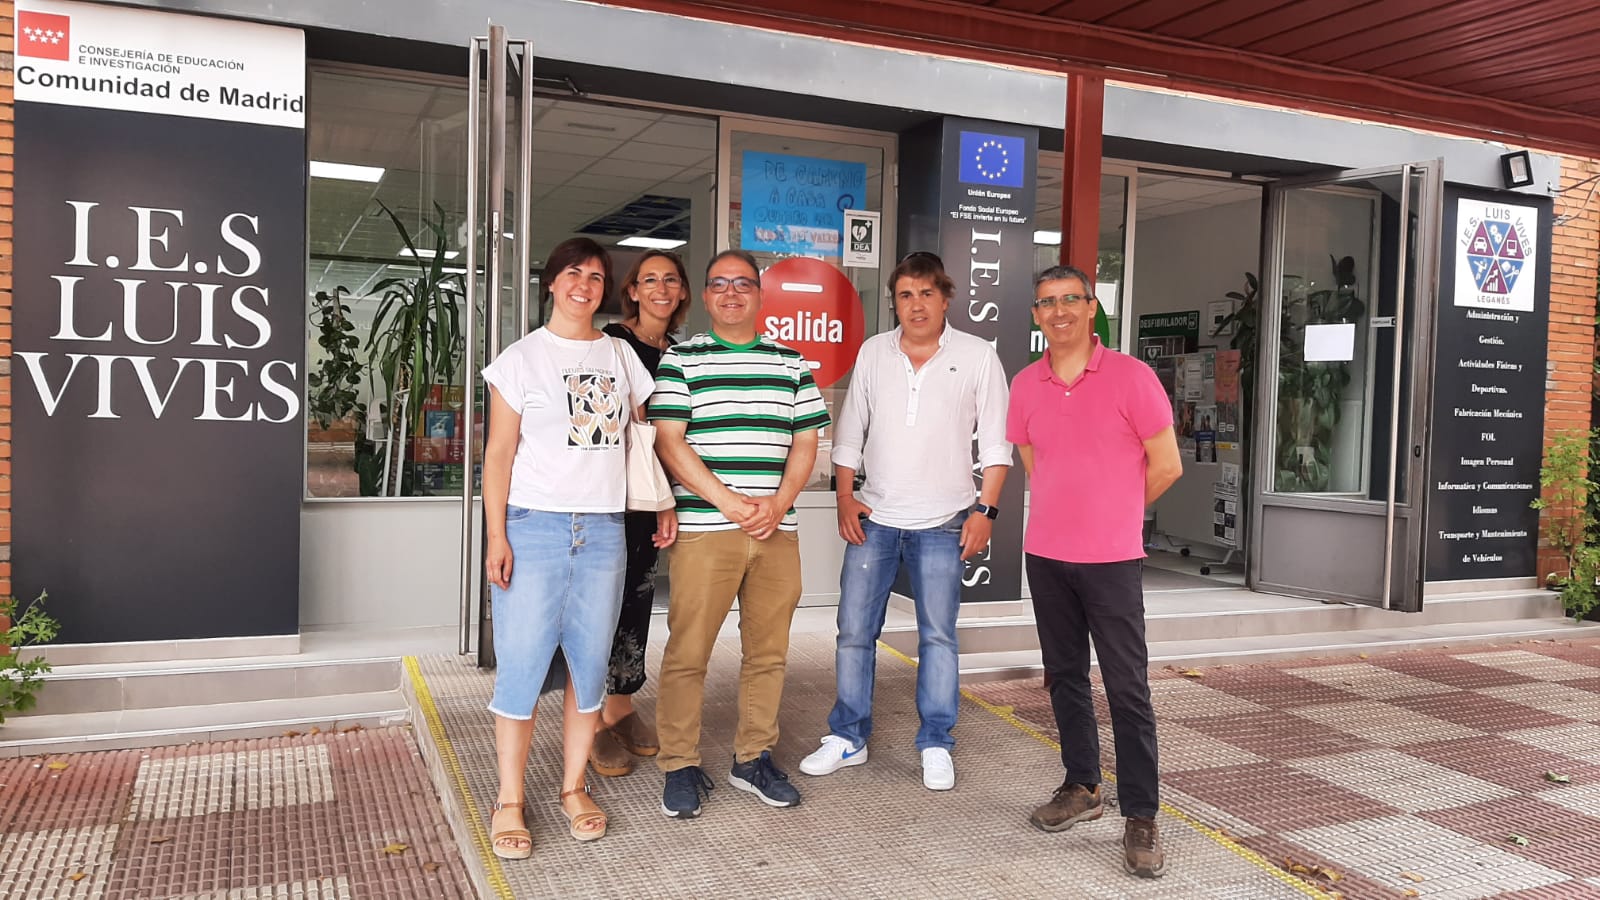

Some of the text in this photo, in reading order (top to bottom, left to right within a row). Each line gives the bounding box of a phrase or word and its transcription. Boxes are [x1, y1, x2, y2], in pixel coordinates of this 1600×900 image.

[78, 44, 244, 71] CONSEJERÍA DE EDUCACIÓN
[79, 55, 180, 74] E INVESTIGACIÓN
[17, 65, 303, 113] Comunidad de Madrid
[967, 189, 1011, 200] Unión Europea
[959, 204, 1019, 216] Fondo Social Europeo
[960, 212, 972, 220] FSE
[64, 200, 261, 277] I.E.S
[1485, 207, 1511, 220] LUIS
[1515, 216, 1533, 258] VIVES
[854, 243, 870, 251] DEA
[968, 227, 1001, 322] I.E.S
[49, 275, 272, 349] LUIS
[1466, 309, 1520, 324] Administración y
[765, 311, 843, 343] salida
[1140, 316, 1188, 328] DESFIBRILADOR
[1458, 358, 1523, 372] Actividades Físicas y
[13, 351, 300, 423] VIVES
[1454, 408, 1523, 419] Fabricación Mecánica
[1461, 457, 1514, 467] Imagen Personal
[1477, 483, 1482, 492] y
[1483, 481, 1533, 490] Comunicaciones
[1472, 506, 1498, 514] Idiomas
[1438, 529, 1527, 541] Transporte y Mantenimiento
[1462, 553, 1503, 563] de Vehículos
